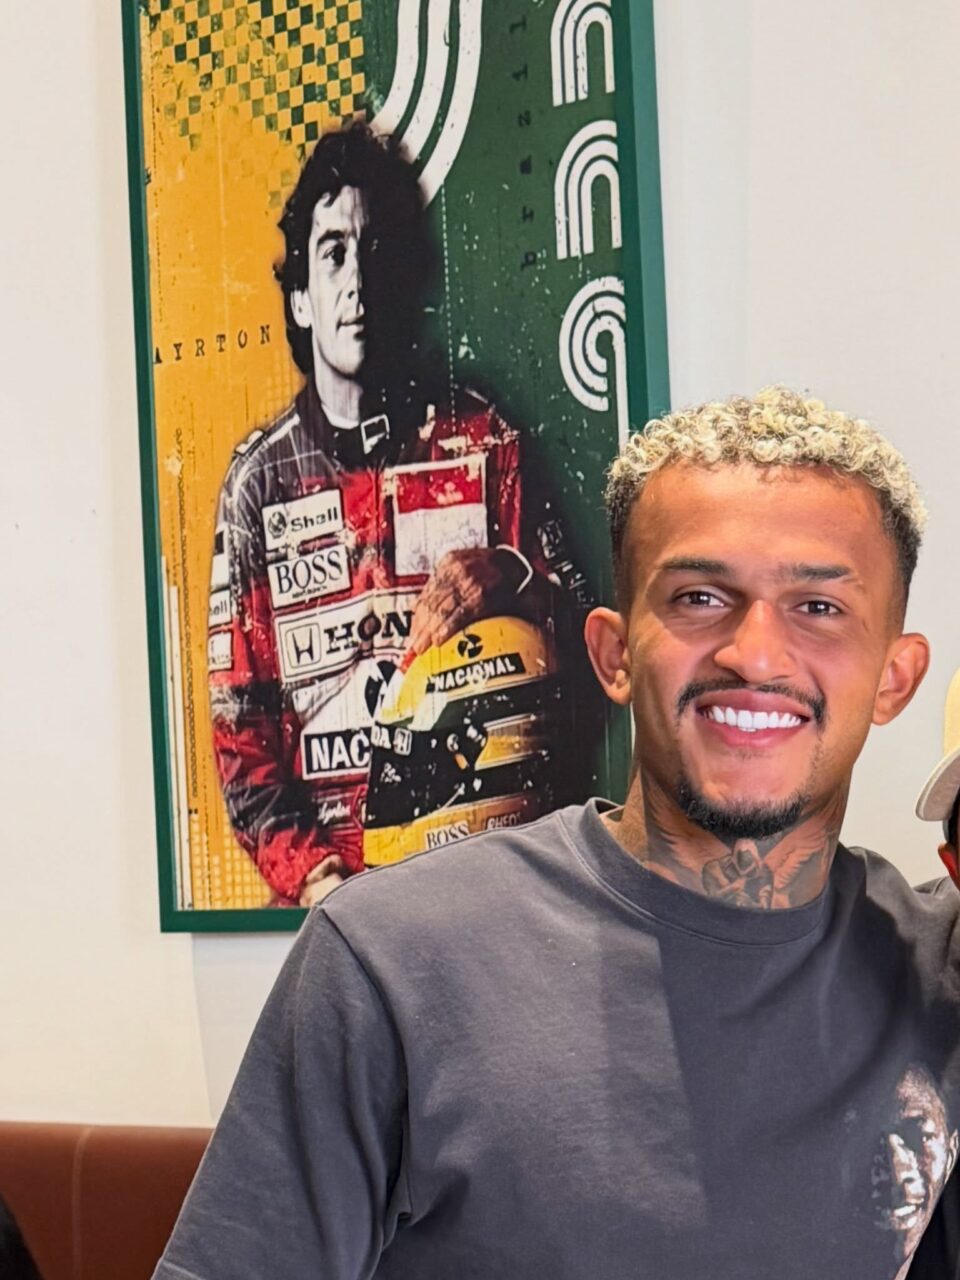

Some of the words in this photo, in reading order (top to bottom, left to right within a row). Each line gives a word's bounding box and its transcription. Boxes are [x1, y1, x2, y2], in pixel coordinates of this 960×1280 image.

[154, 324, 270, 364] AYRTON
[291, 506, 338, 532] Shell
[275, 550, 343, 594] BOSS
[310, 733, 371, 771] NAC
